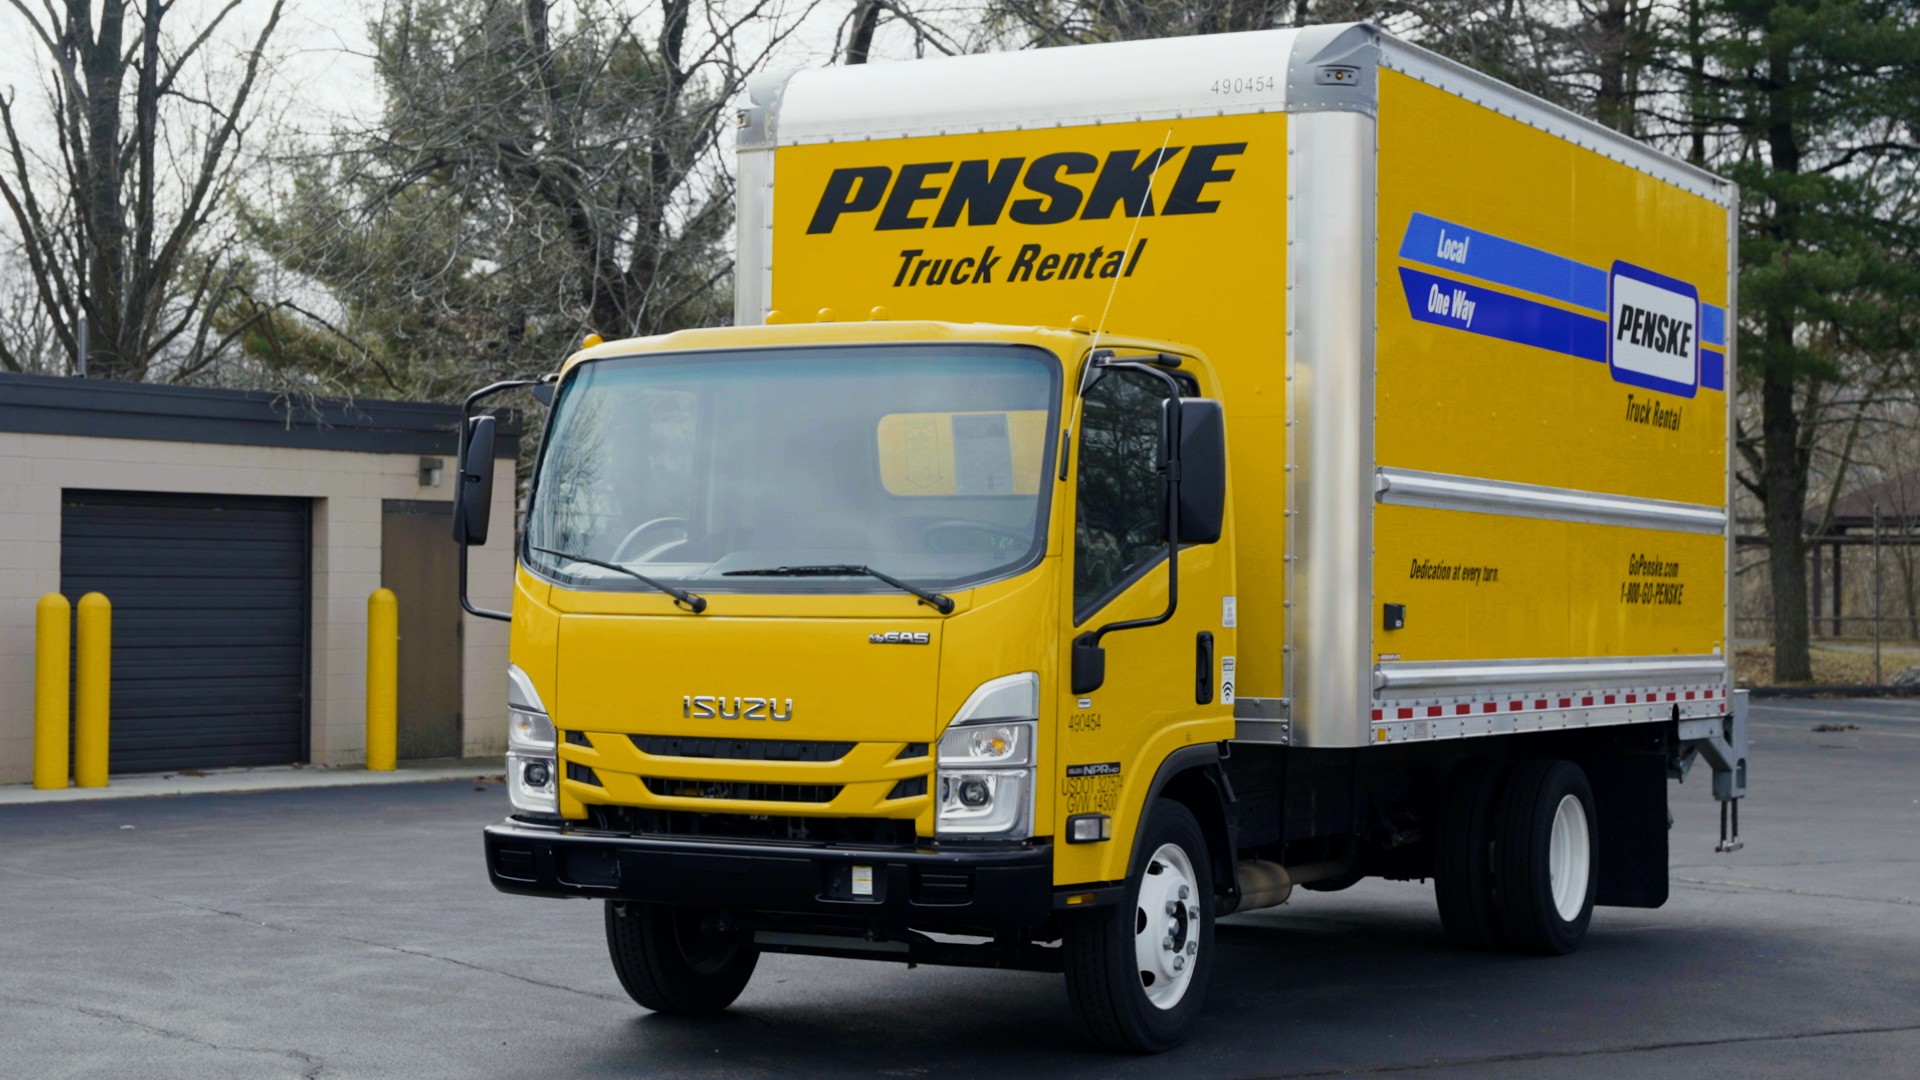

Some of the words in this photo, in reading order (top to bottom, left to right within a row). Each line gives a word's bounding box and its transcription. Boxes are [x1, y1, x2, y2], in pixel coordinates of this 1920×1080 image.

[1211, 76, 1274, 95] 490454
[806, 142, 1248, 235] PENSKE
[1437, 228, 1470, 264] Local
[893, 246, 1002, 287] Truck
[1007, 237, 1148, 283] Rental
[1428, 283, 1450, 316] One
[1451, 288, 1476, 328] Way
[1617, 303, 1693, 358] PENSKE
[1626, 393, 1652, 424] Truck
[1652, 400, 1683, 431] Rental
[1410, 558, 1452, 580] Dedication
[1452, 564, 1462, 581] at
[1462, 566, 1482, 586] every
[1629, 552, 1679, 578] GoPenske.com
[1620, 582, 1684, 605] 1-800-GO-PENSKE
[683, 695, 793, 721] ISUZU
[1068, 713, 1102, 732] 490454
[1062, 776, 1095, 796] USDOT
[1067, 793, 1091, 813] GVW
[1093, 793, 1119, 811] 14500
